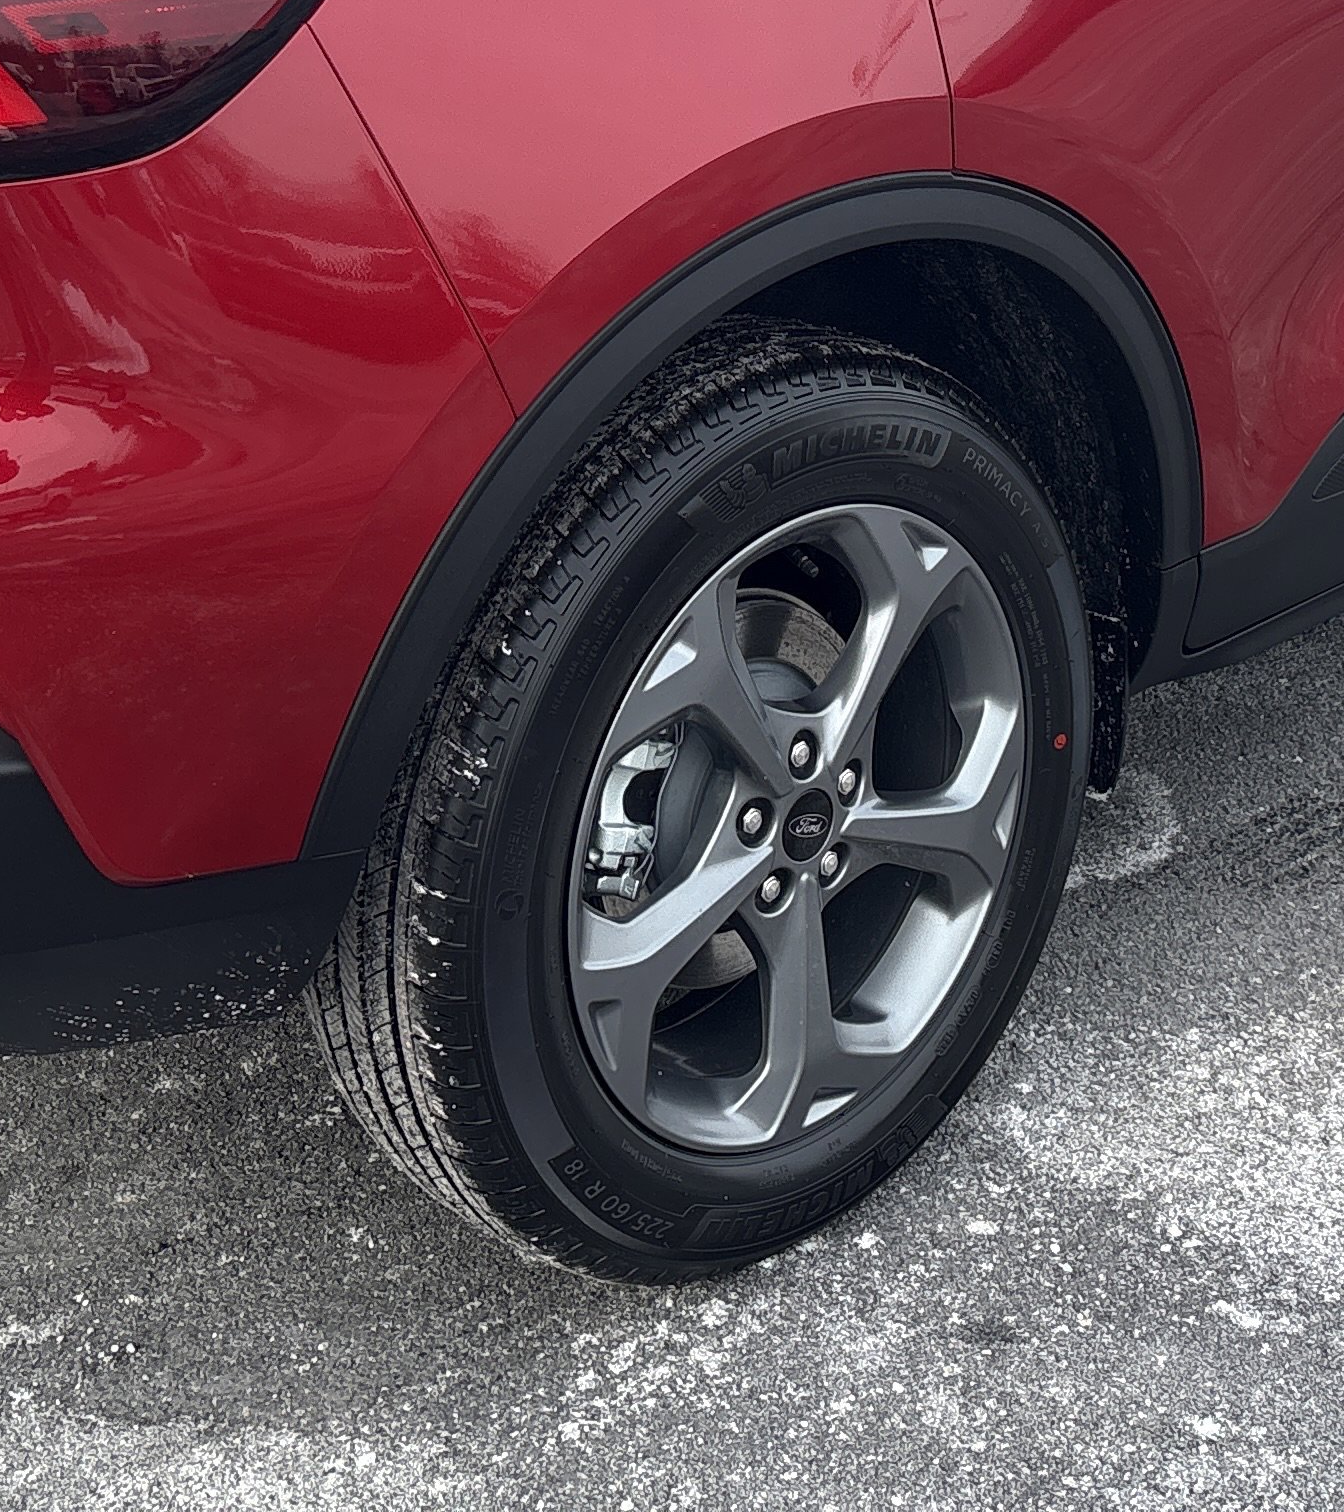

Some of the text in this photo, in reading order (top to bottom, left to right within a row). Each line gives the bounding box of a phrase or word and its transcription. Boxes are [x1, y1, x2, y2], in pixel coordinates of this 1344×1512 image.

[772, 423, 943, 479] MICHELIN
[962, 447, 1032, 517] PRIMACY
[796, 818, 823, 833] Ford
[563, 1159, 675, 1239] 225/60 R 18
[698, 1157, 876, 1242] MICHELIN
